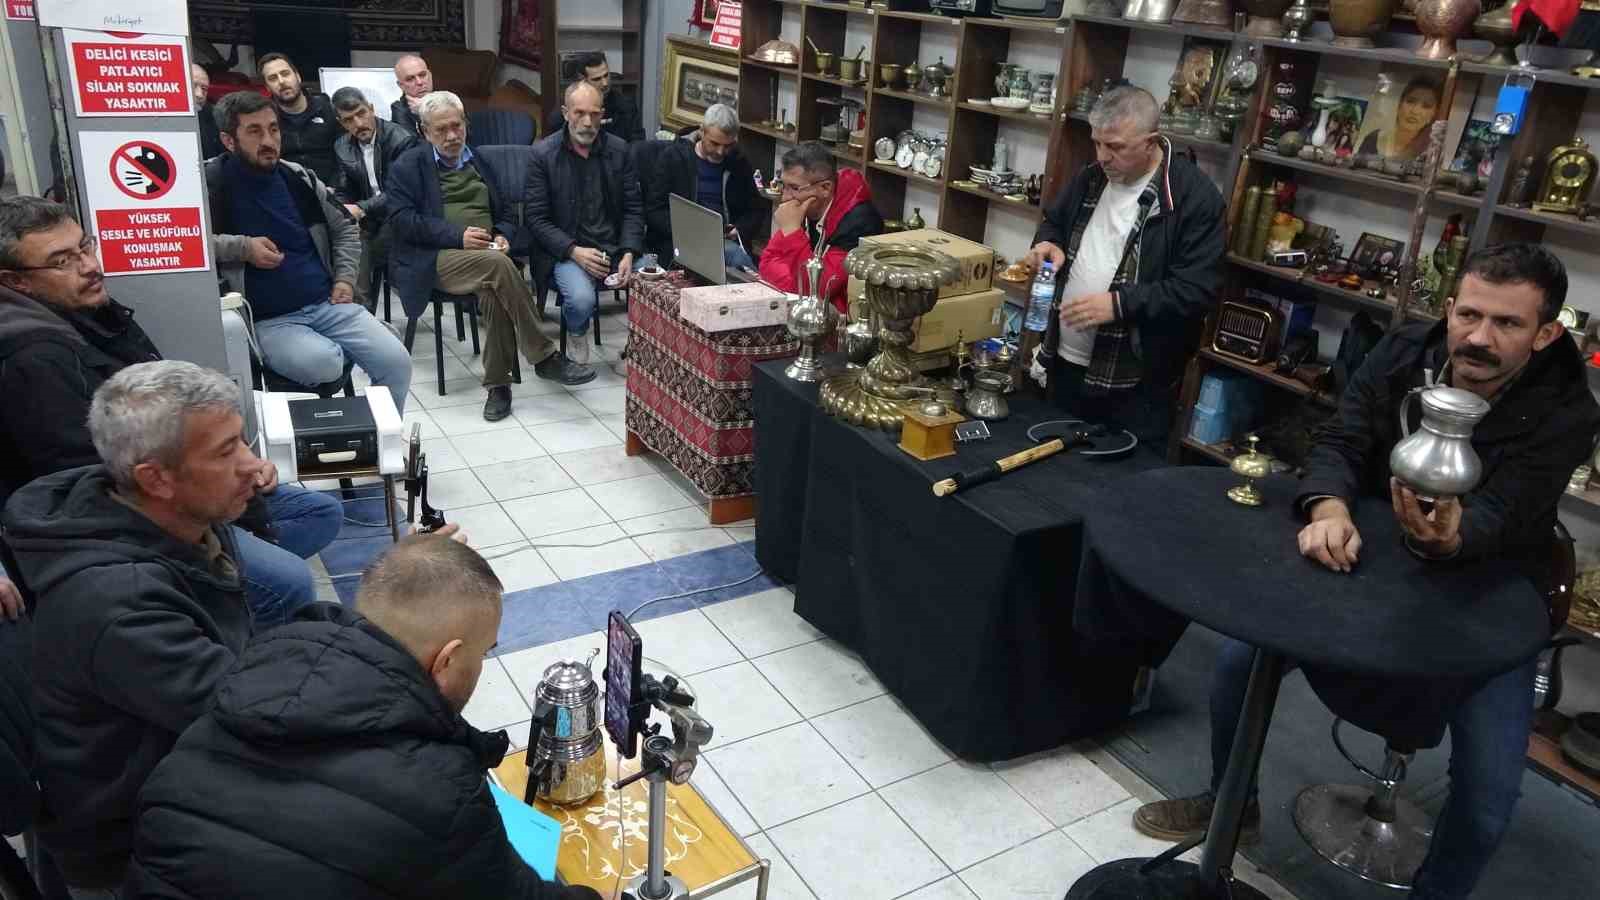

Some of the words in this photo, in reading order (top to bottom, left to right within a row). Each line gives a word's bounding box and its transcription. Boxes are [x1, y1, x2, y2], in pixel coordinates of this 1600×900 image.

[85, 47, 127, 60] DELİCİ
[131, 48, 172, 61] KESİCİ
[99, 65, 163, 77] PATLAYICI
[86, 80, 124, 93] SİLAH
[127, 82, 181, 93] SOKMAK
[104, 98, 167, 109] YASAKTIR
[128, 212, 171, 224] YÜKSEK
[101, 229, 135, 240] SESLE
[136, 228, 151, 239] VE
[153, 225, 200, 238] KÜFÜRLÜ
[123, 242, 183, 255] KONUŞMAK
[130, 256, 181, 268] YASAKTIR
